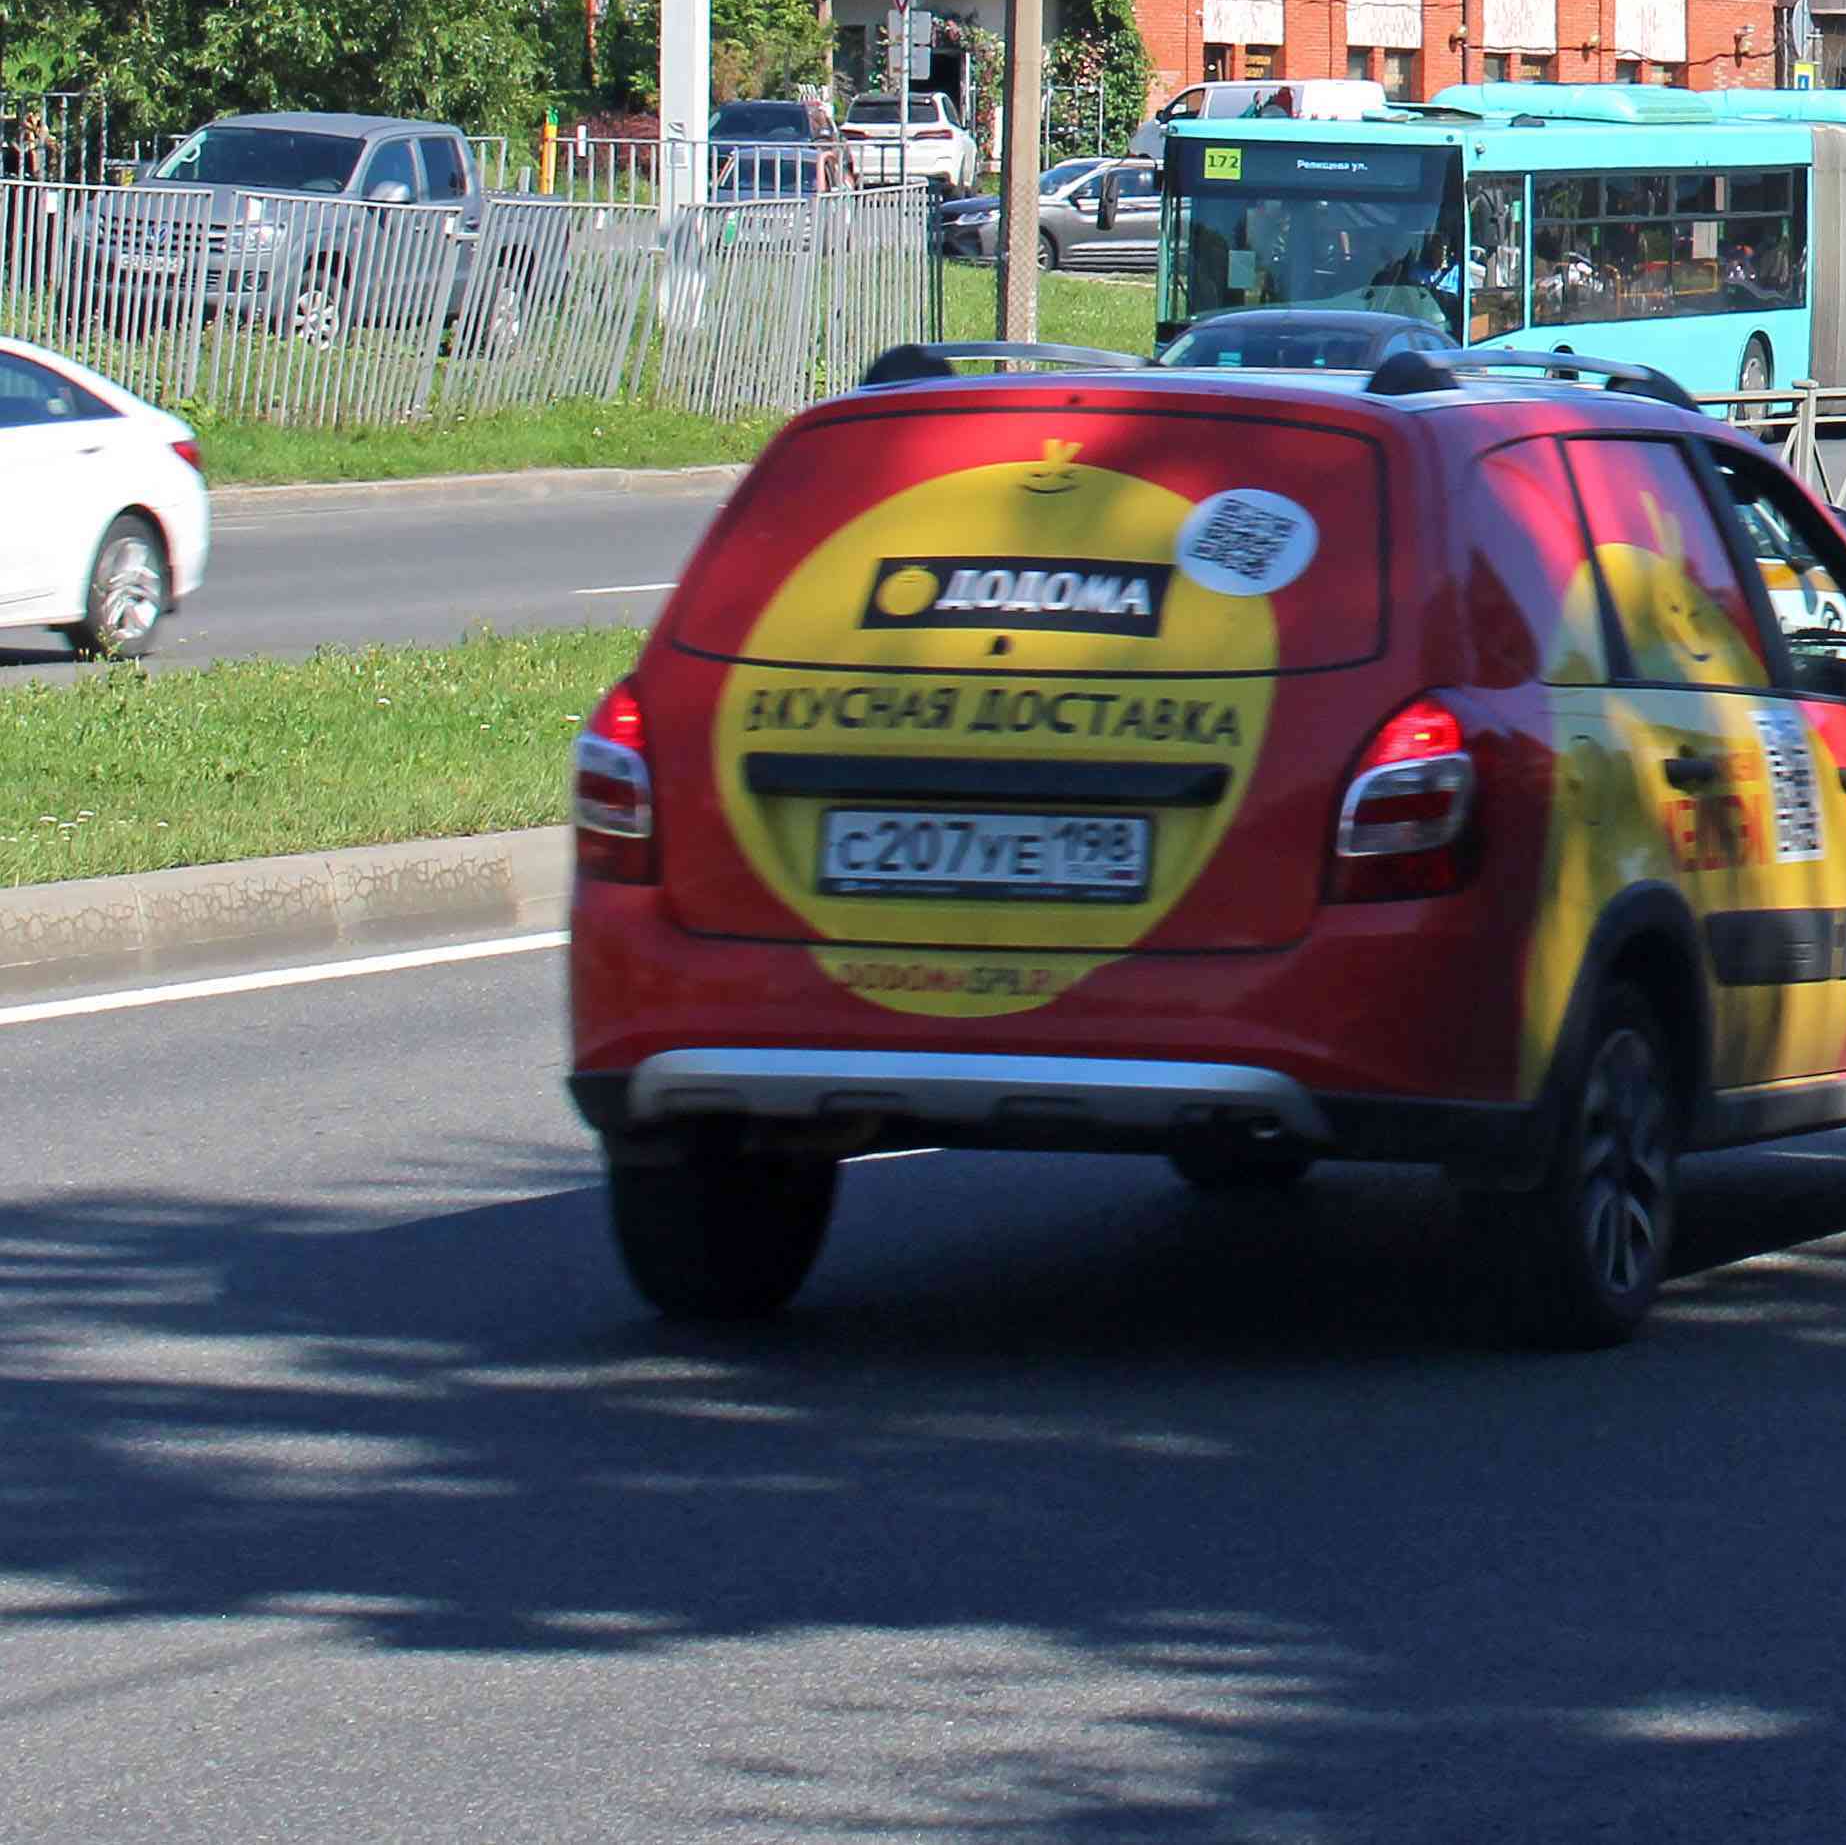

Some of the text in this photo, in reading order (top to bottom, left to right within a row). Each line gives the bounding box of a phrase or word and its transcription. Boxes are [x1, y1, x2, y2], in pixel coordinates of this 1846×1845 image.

[1207, 155, 1239, 169] 172
[936, 569, 1152, 617] ДОДОМА
[744, 686, 1243, 748] ВКУСНАЯ ДОСТАВКА
